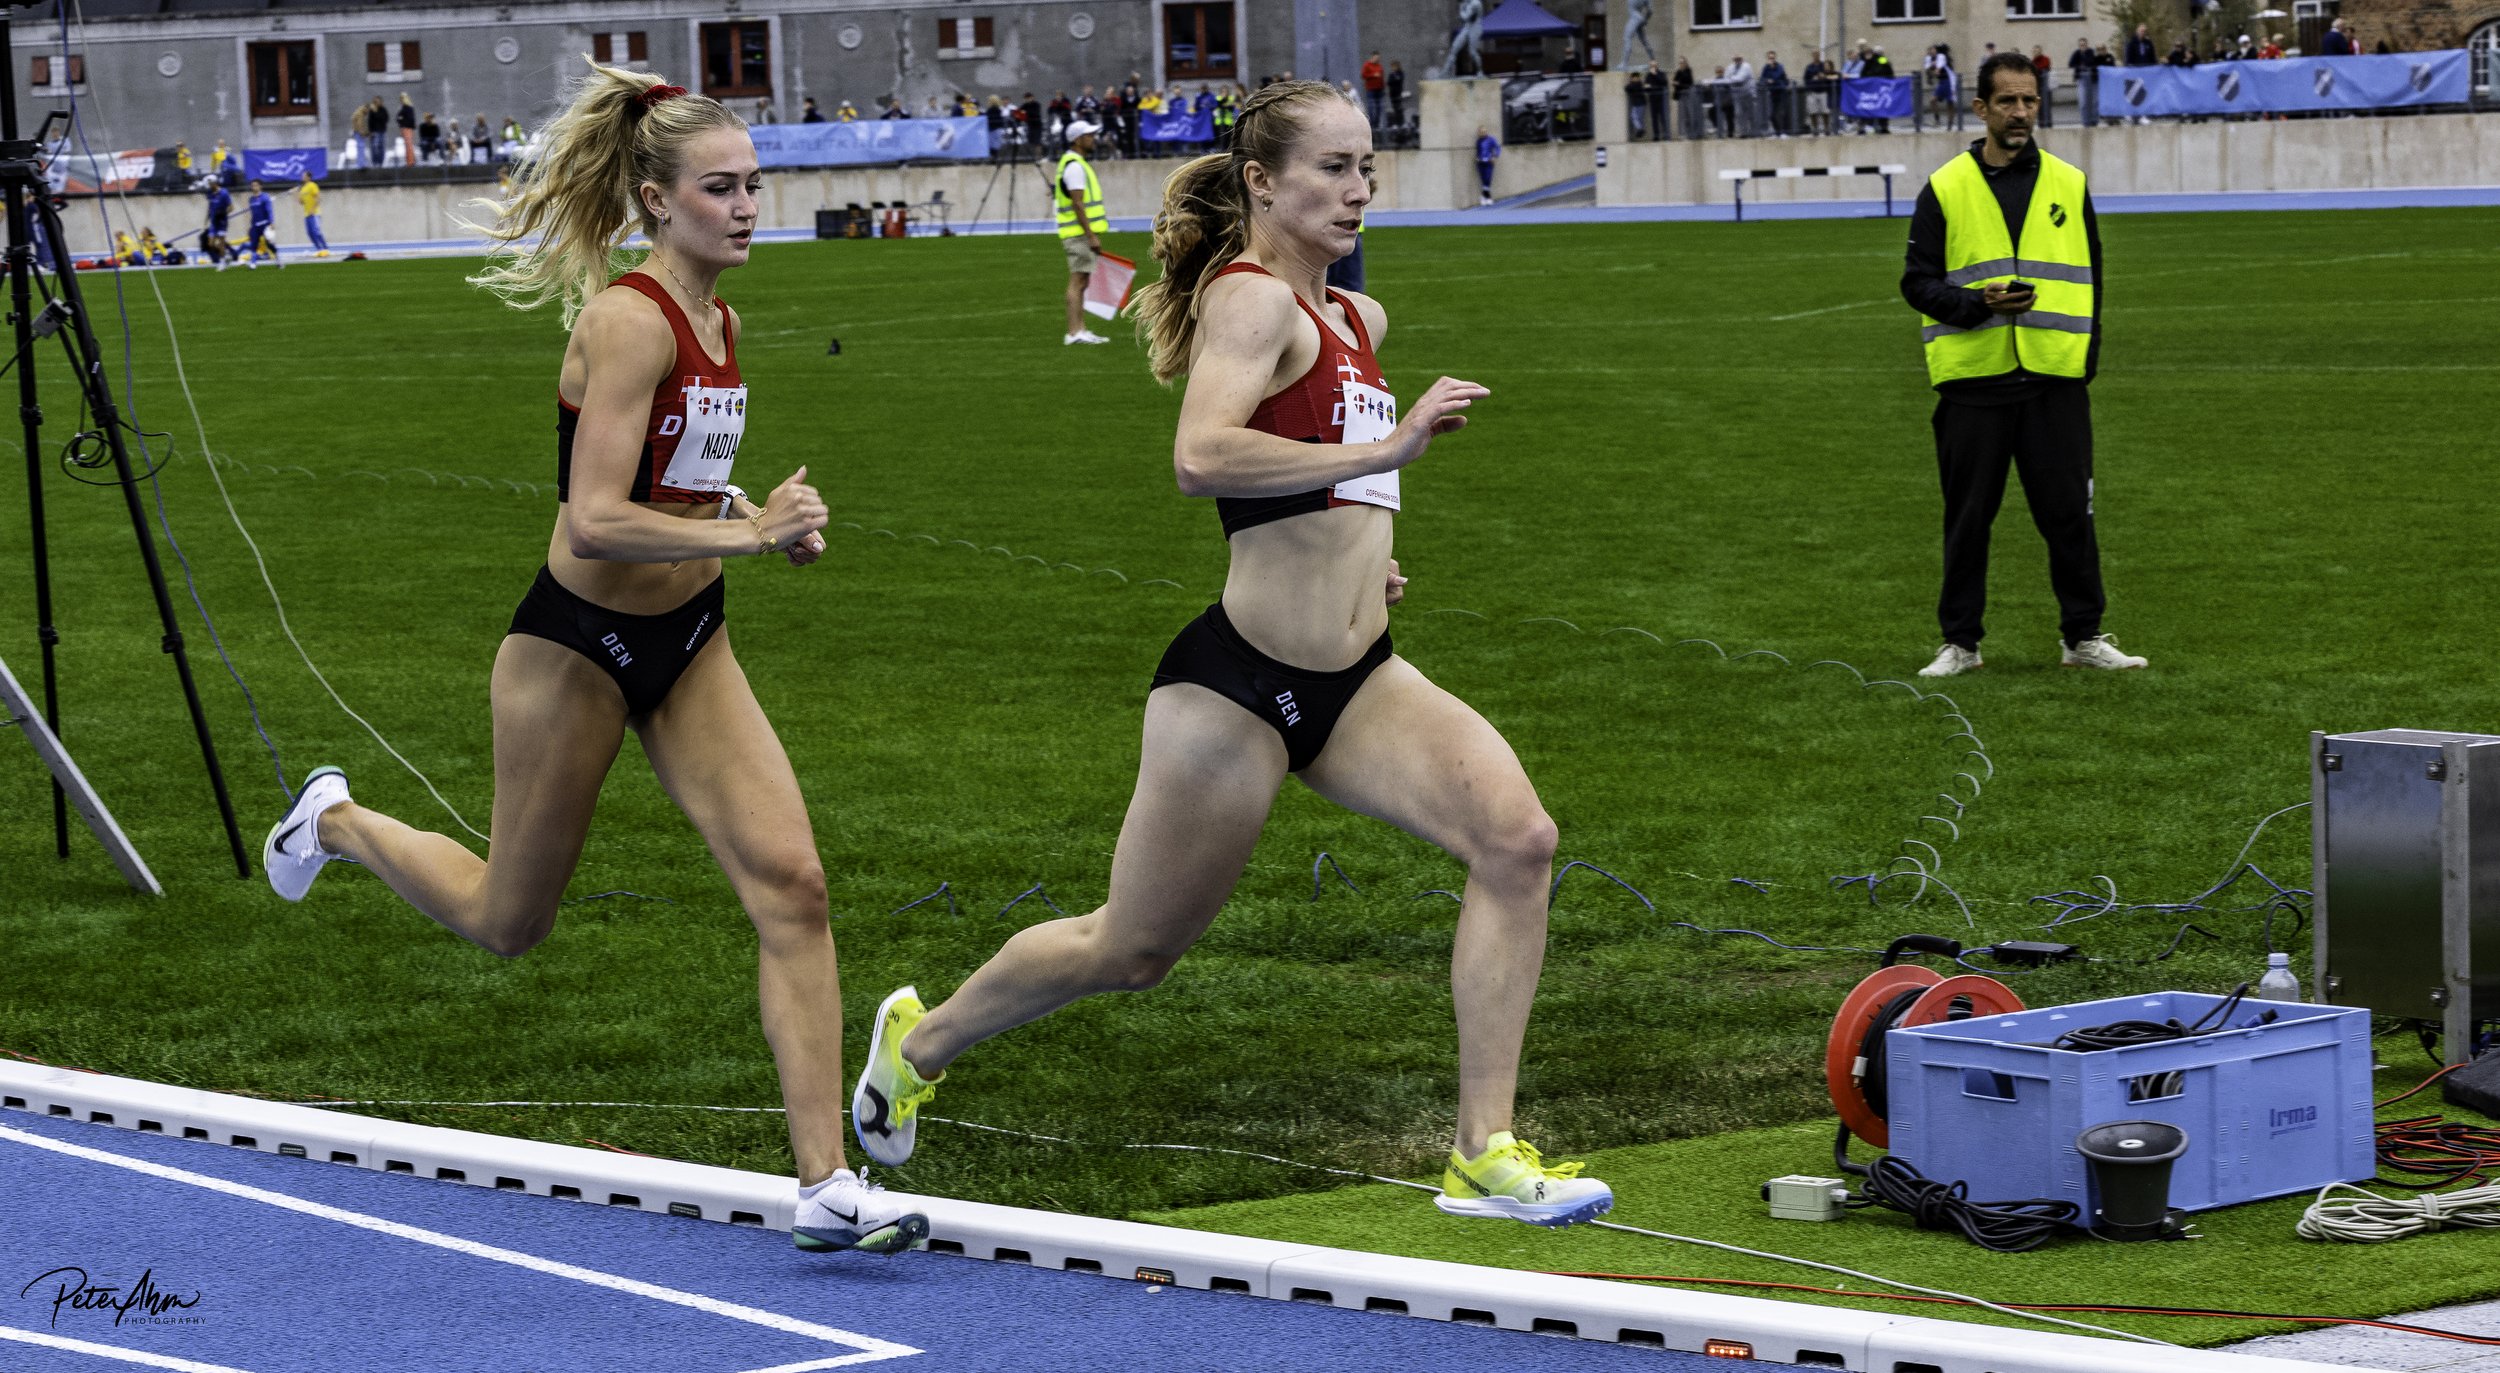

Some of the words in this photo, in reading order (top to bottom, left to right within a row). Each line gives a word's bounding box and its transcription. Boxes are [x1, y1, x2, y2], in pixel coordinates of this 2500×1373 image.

[701, 433, 739, 460] NADJA
[1366, 488, 1390, 501] COPENHAGEN
[601, 632, 632, 667] DEN
[686, 619, 705, 651] CRAFT
[1275, 690, 1301, 727] DEN
[2269, 1105, 2317, 1128] Irma
